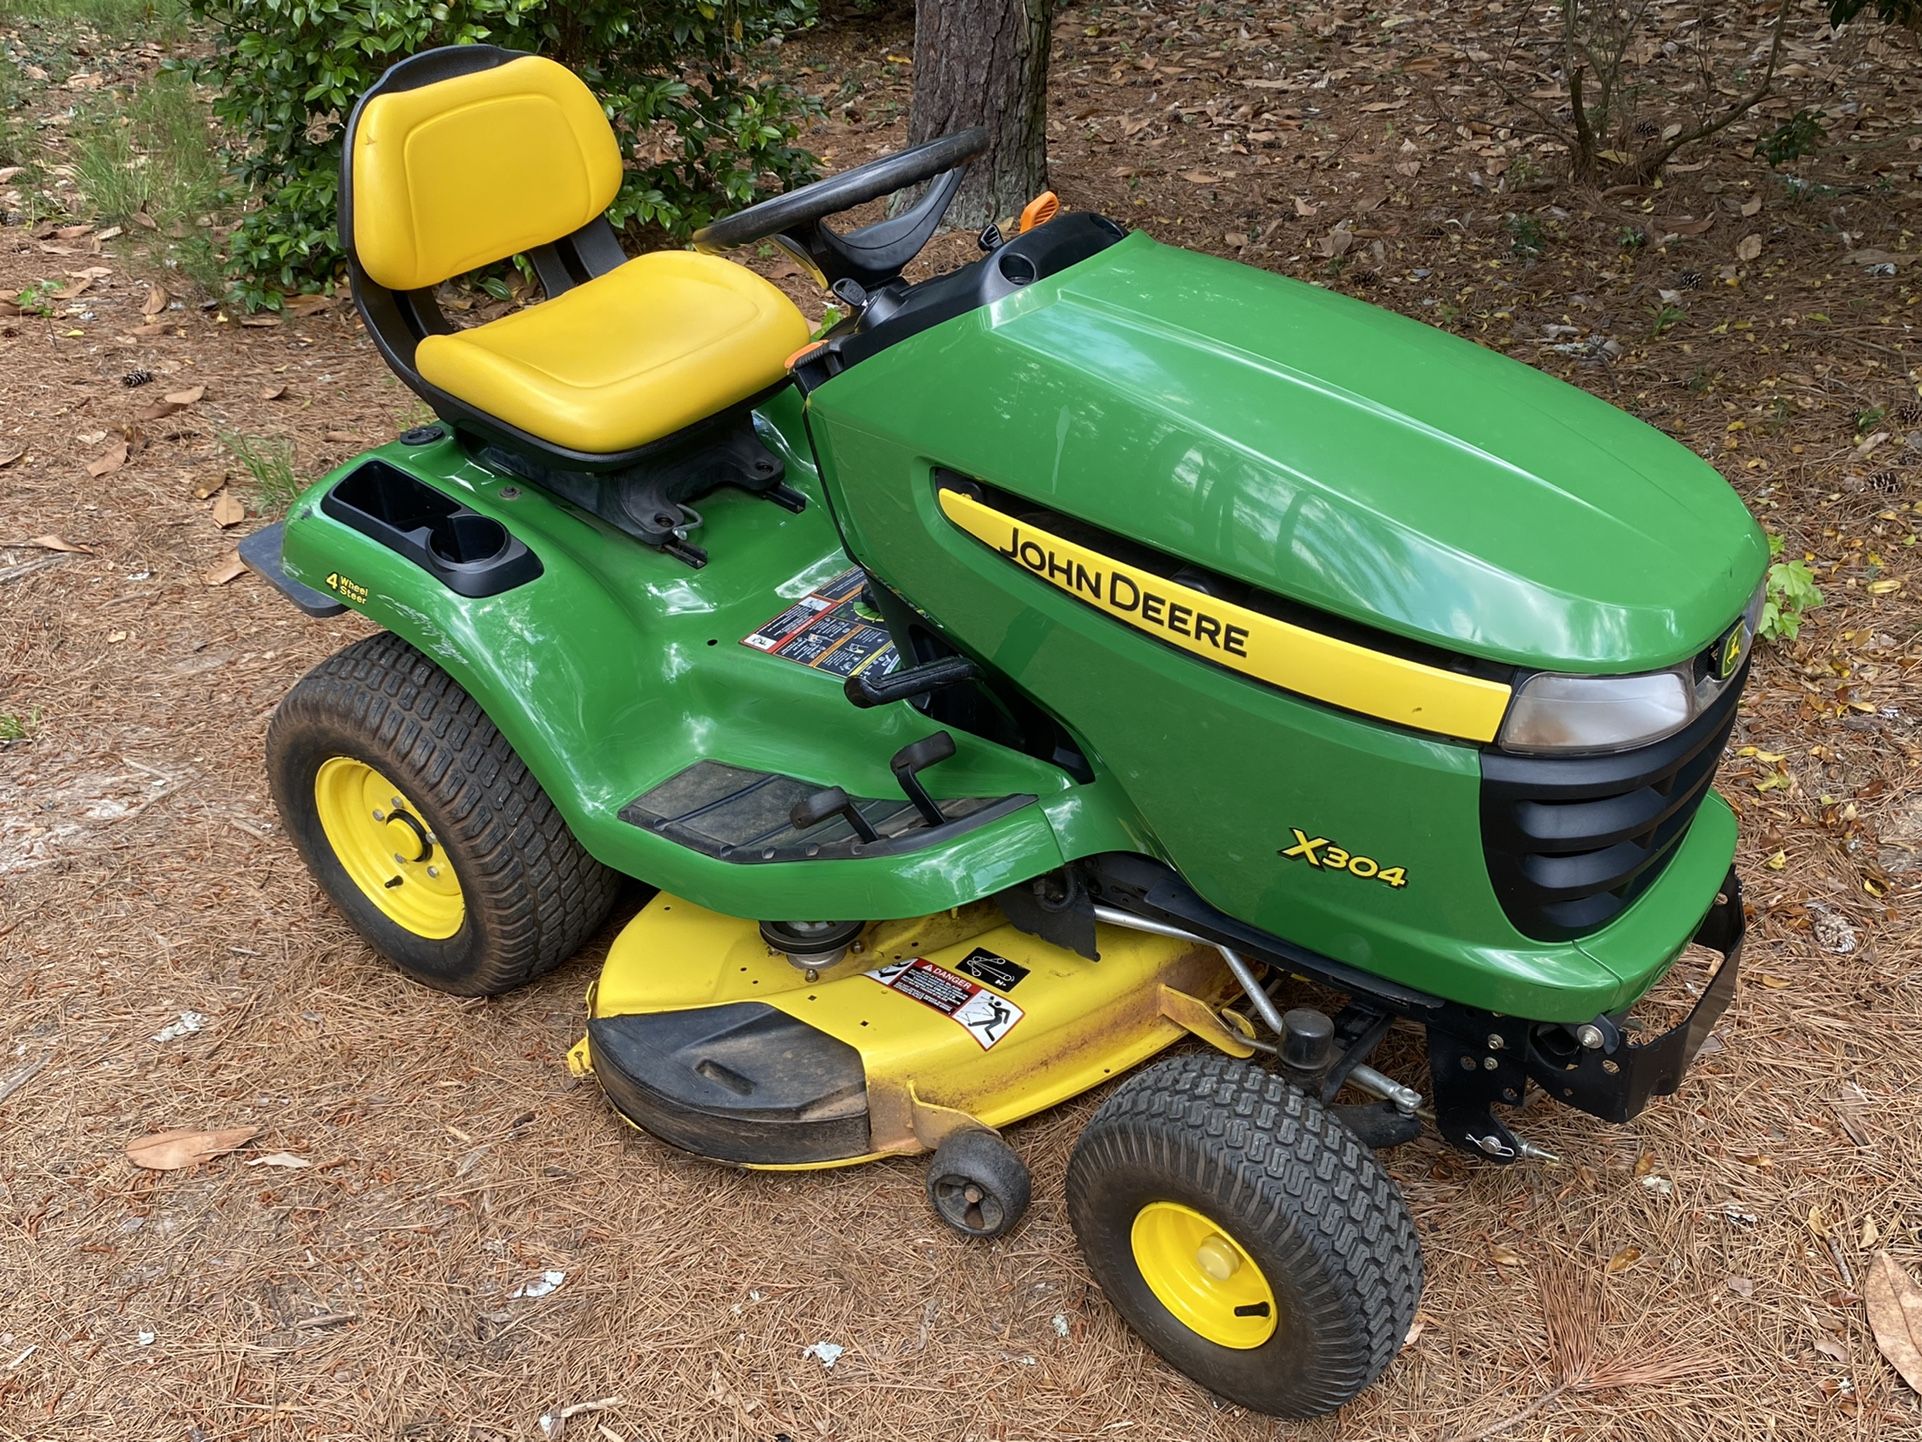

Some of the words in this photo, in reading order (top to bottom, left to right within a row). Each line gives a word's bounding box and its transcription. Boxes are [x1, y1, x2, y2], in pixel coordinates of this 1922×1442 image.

[325, 572, 339, 590] 4
[340, 575, 368, 597] Wheel
[340, 585, 367, 605] Steer
[999, 527, 1102, 600] JOHN
[1109, 571, 1250, 658] DEERE
[1279, 828, 1407, 888] X304
[933, 967, 972, 990] DANGER
